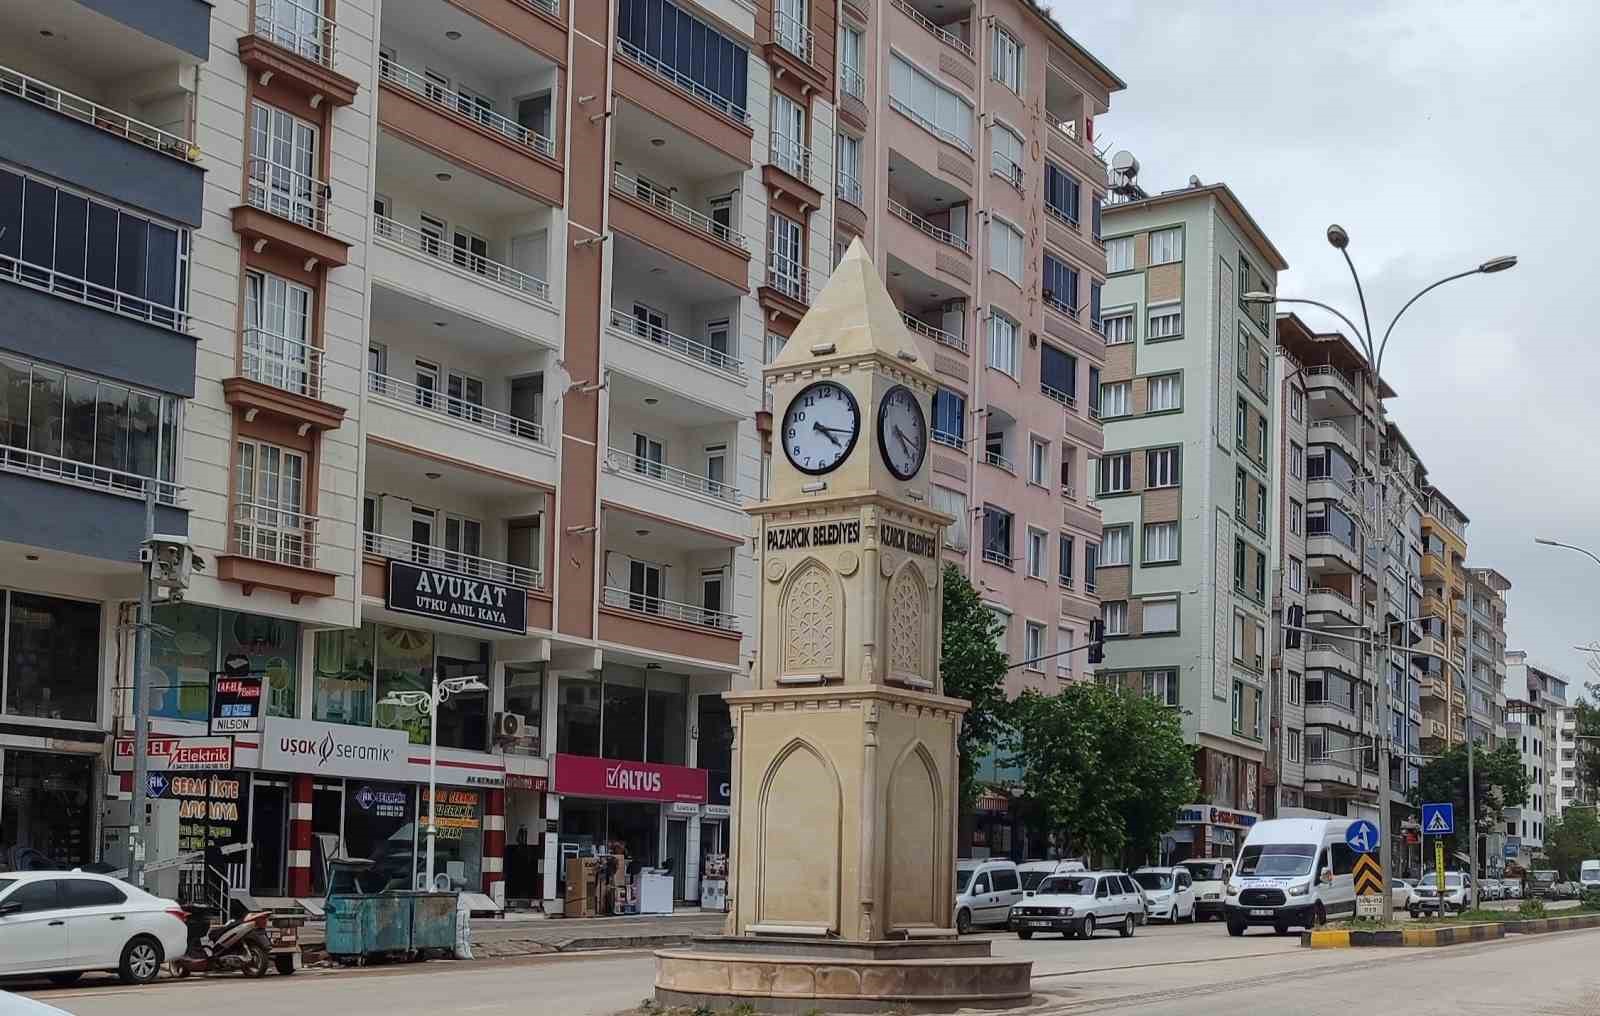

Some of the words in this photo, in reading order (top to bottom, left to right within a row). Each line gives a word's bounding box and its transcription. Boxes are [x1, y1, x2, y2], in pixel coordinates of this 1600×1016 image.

[818, 386, 831, 399] 12
[804, 396, 814, 407] 11
[793, 411, 806, 422] 10
[788, 428, 796, 439] 9
[793, 446, 800, 456] 8
[803, 457, 810, 467] 7
[818, 459, 826, 470] 6
[767, 527, 810, 550] PAZARCIK
[813, 520, 860, 546] BELEDİYESİ
[416, 571, 507, 608] AVUKAT
[416, 596, 447, 612] UTKU
[449, 602, 475, 617] ANIL
[478, 607, 507, 624] KAYA
[217, 719, 249, 729] NILSON
[180, 750, 227, 762] Elektrik
[619, 769, 661, 792] ALTUS
